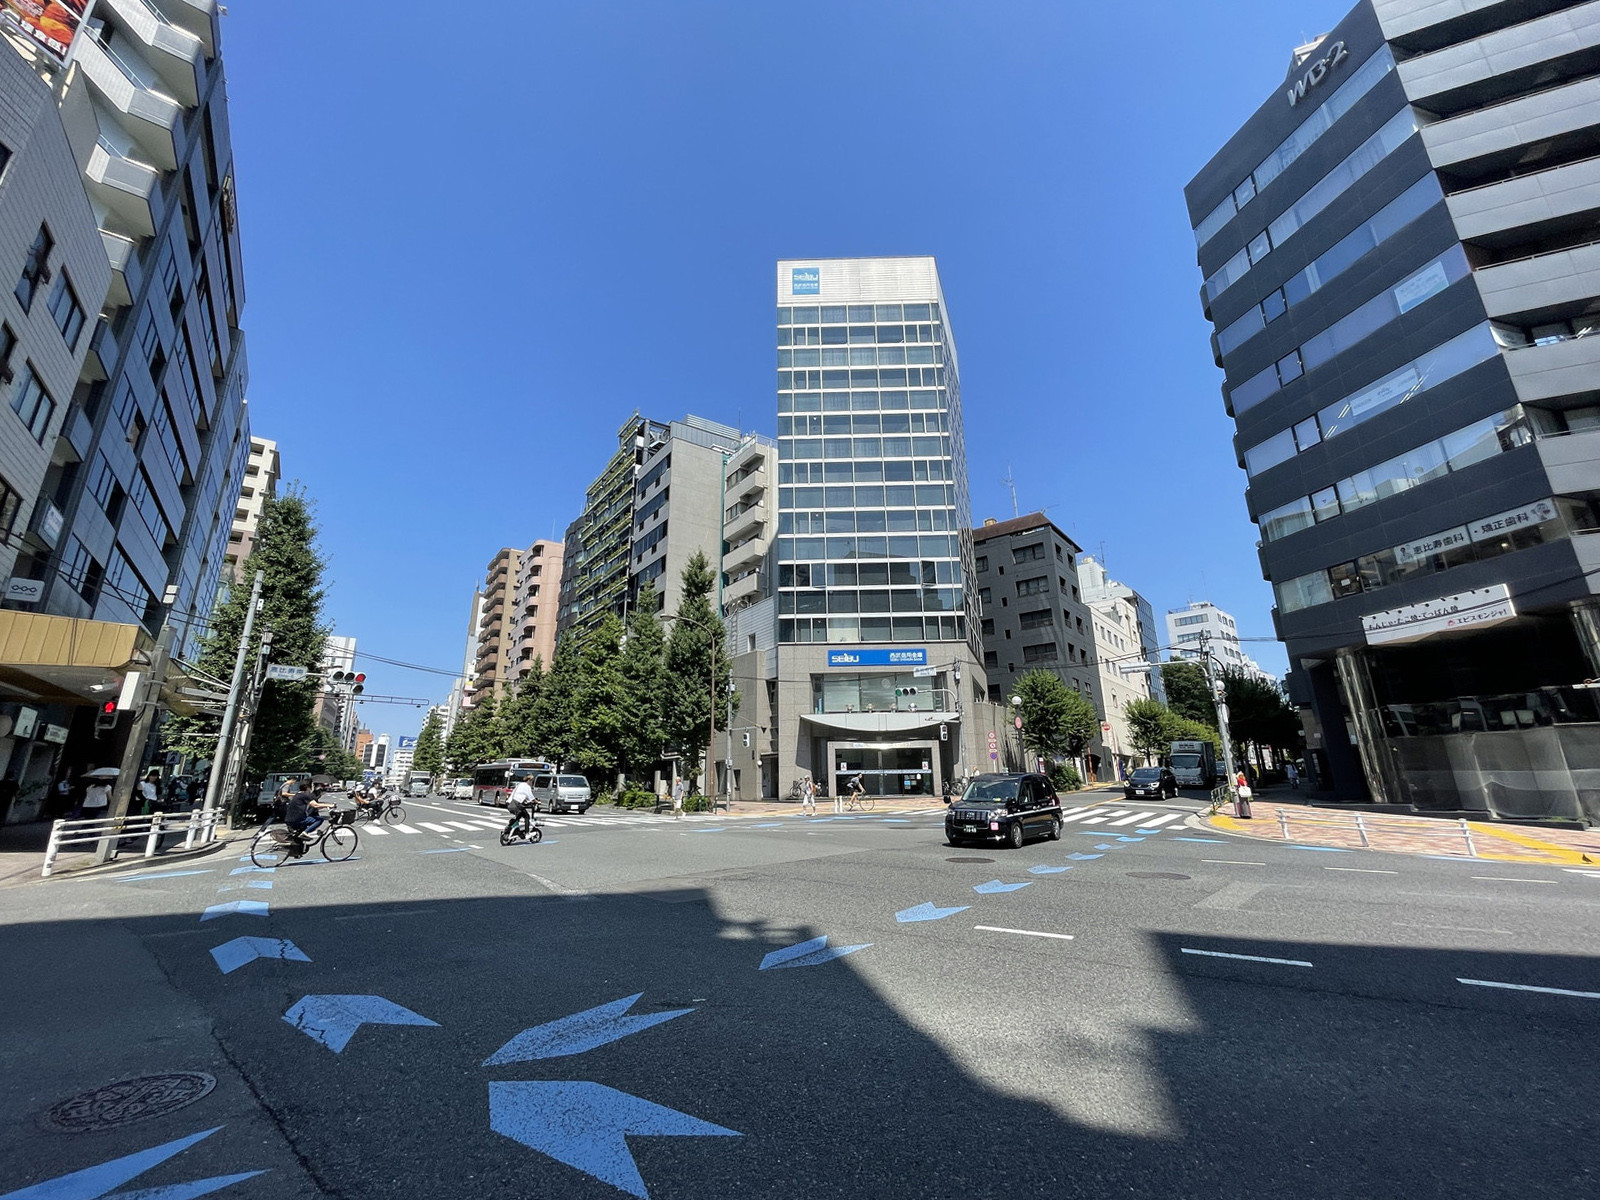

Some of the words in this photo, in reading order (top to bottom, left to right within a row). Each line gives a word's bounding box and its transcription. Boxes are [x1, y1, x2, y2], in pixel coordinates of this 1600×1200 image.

[1412, 532, 1464, 555] 恵比寿歯科
